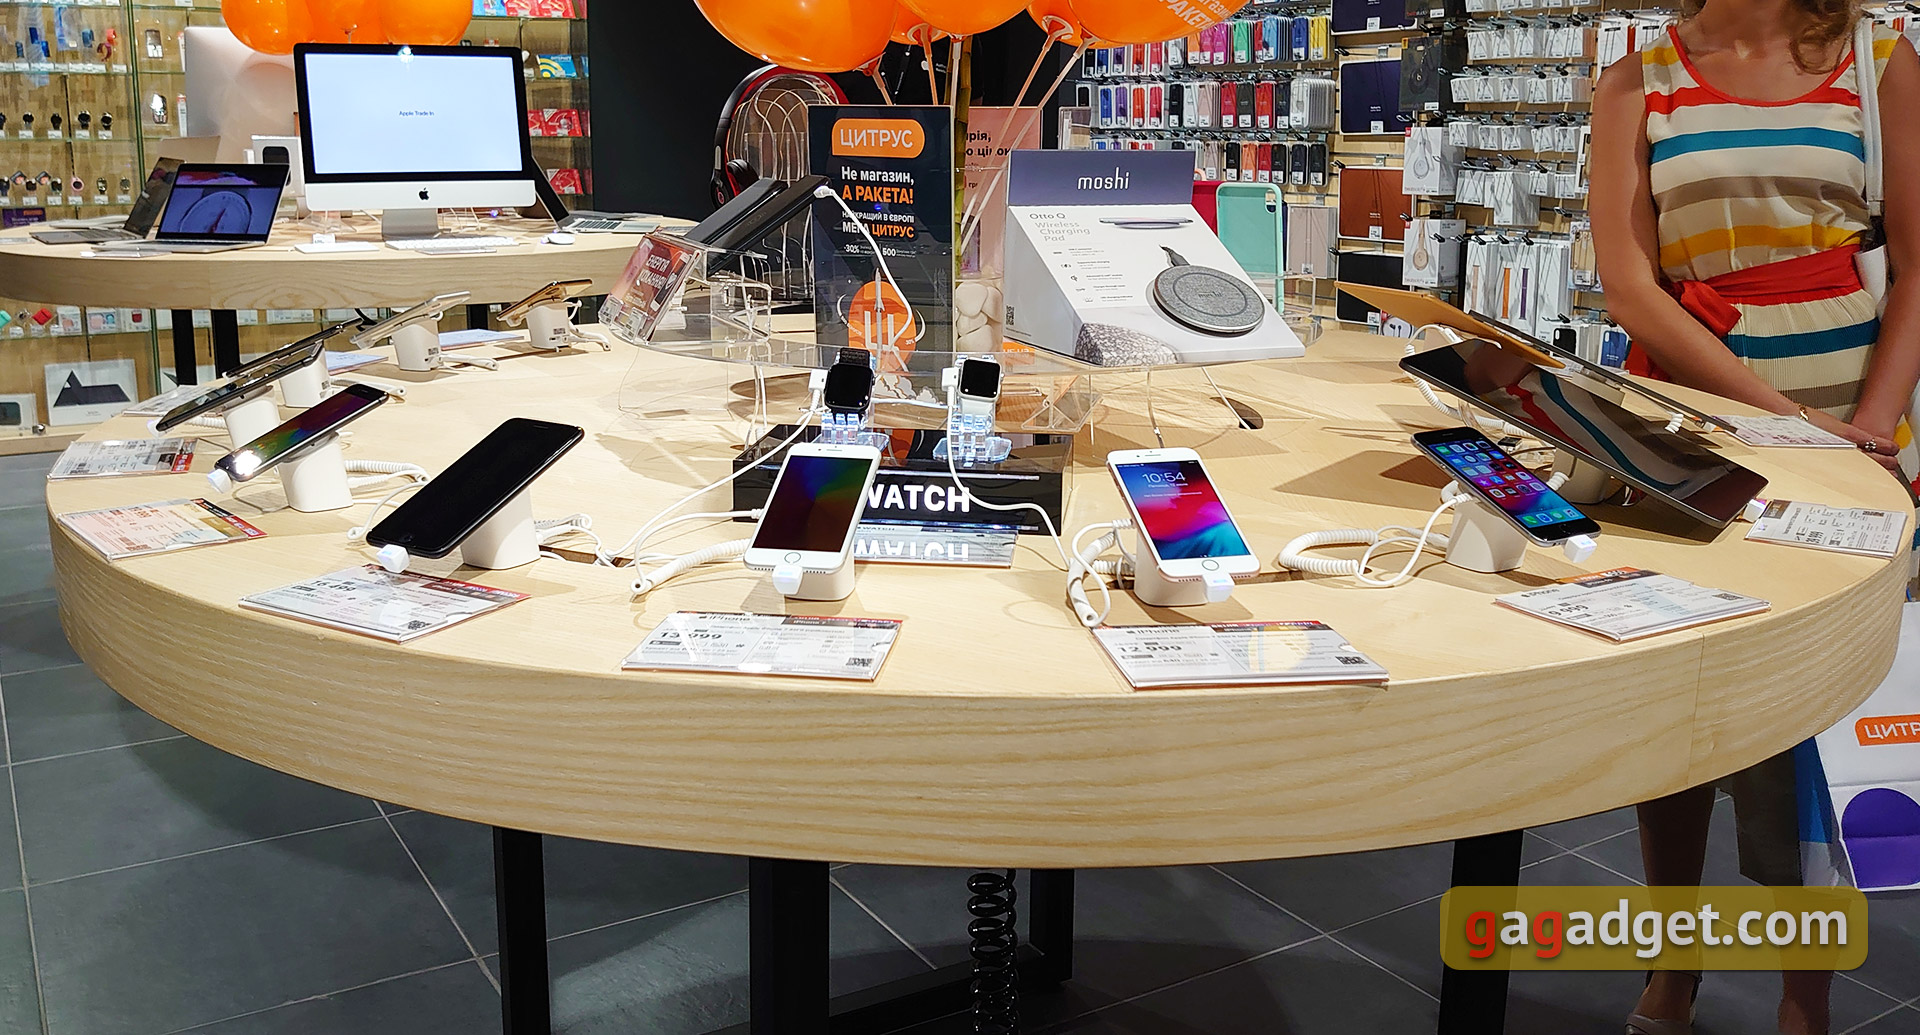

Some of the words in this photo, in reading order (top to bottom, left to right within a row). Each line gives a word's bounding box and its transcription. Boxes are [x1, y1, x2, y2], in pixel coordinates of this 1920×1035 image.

[840, 128, 914, 148] ЦИТРУС
[841, 166, 858, 180] Не
[860, 170, 915, 186] магазин,
[1077, 166, 1130, 190] moshi
[842, 184, 853, 201] А
[855, 185, 914, 205] РАКЕТА!
[889, 214, 915, 224] ЄВРОПІ
[871, 223, 915, 238] ЦИТРУС
[1040, 228, 1091, 236] Charging
[1142, 471, 1186, 484] 10:54
